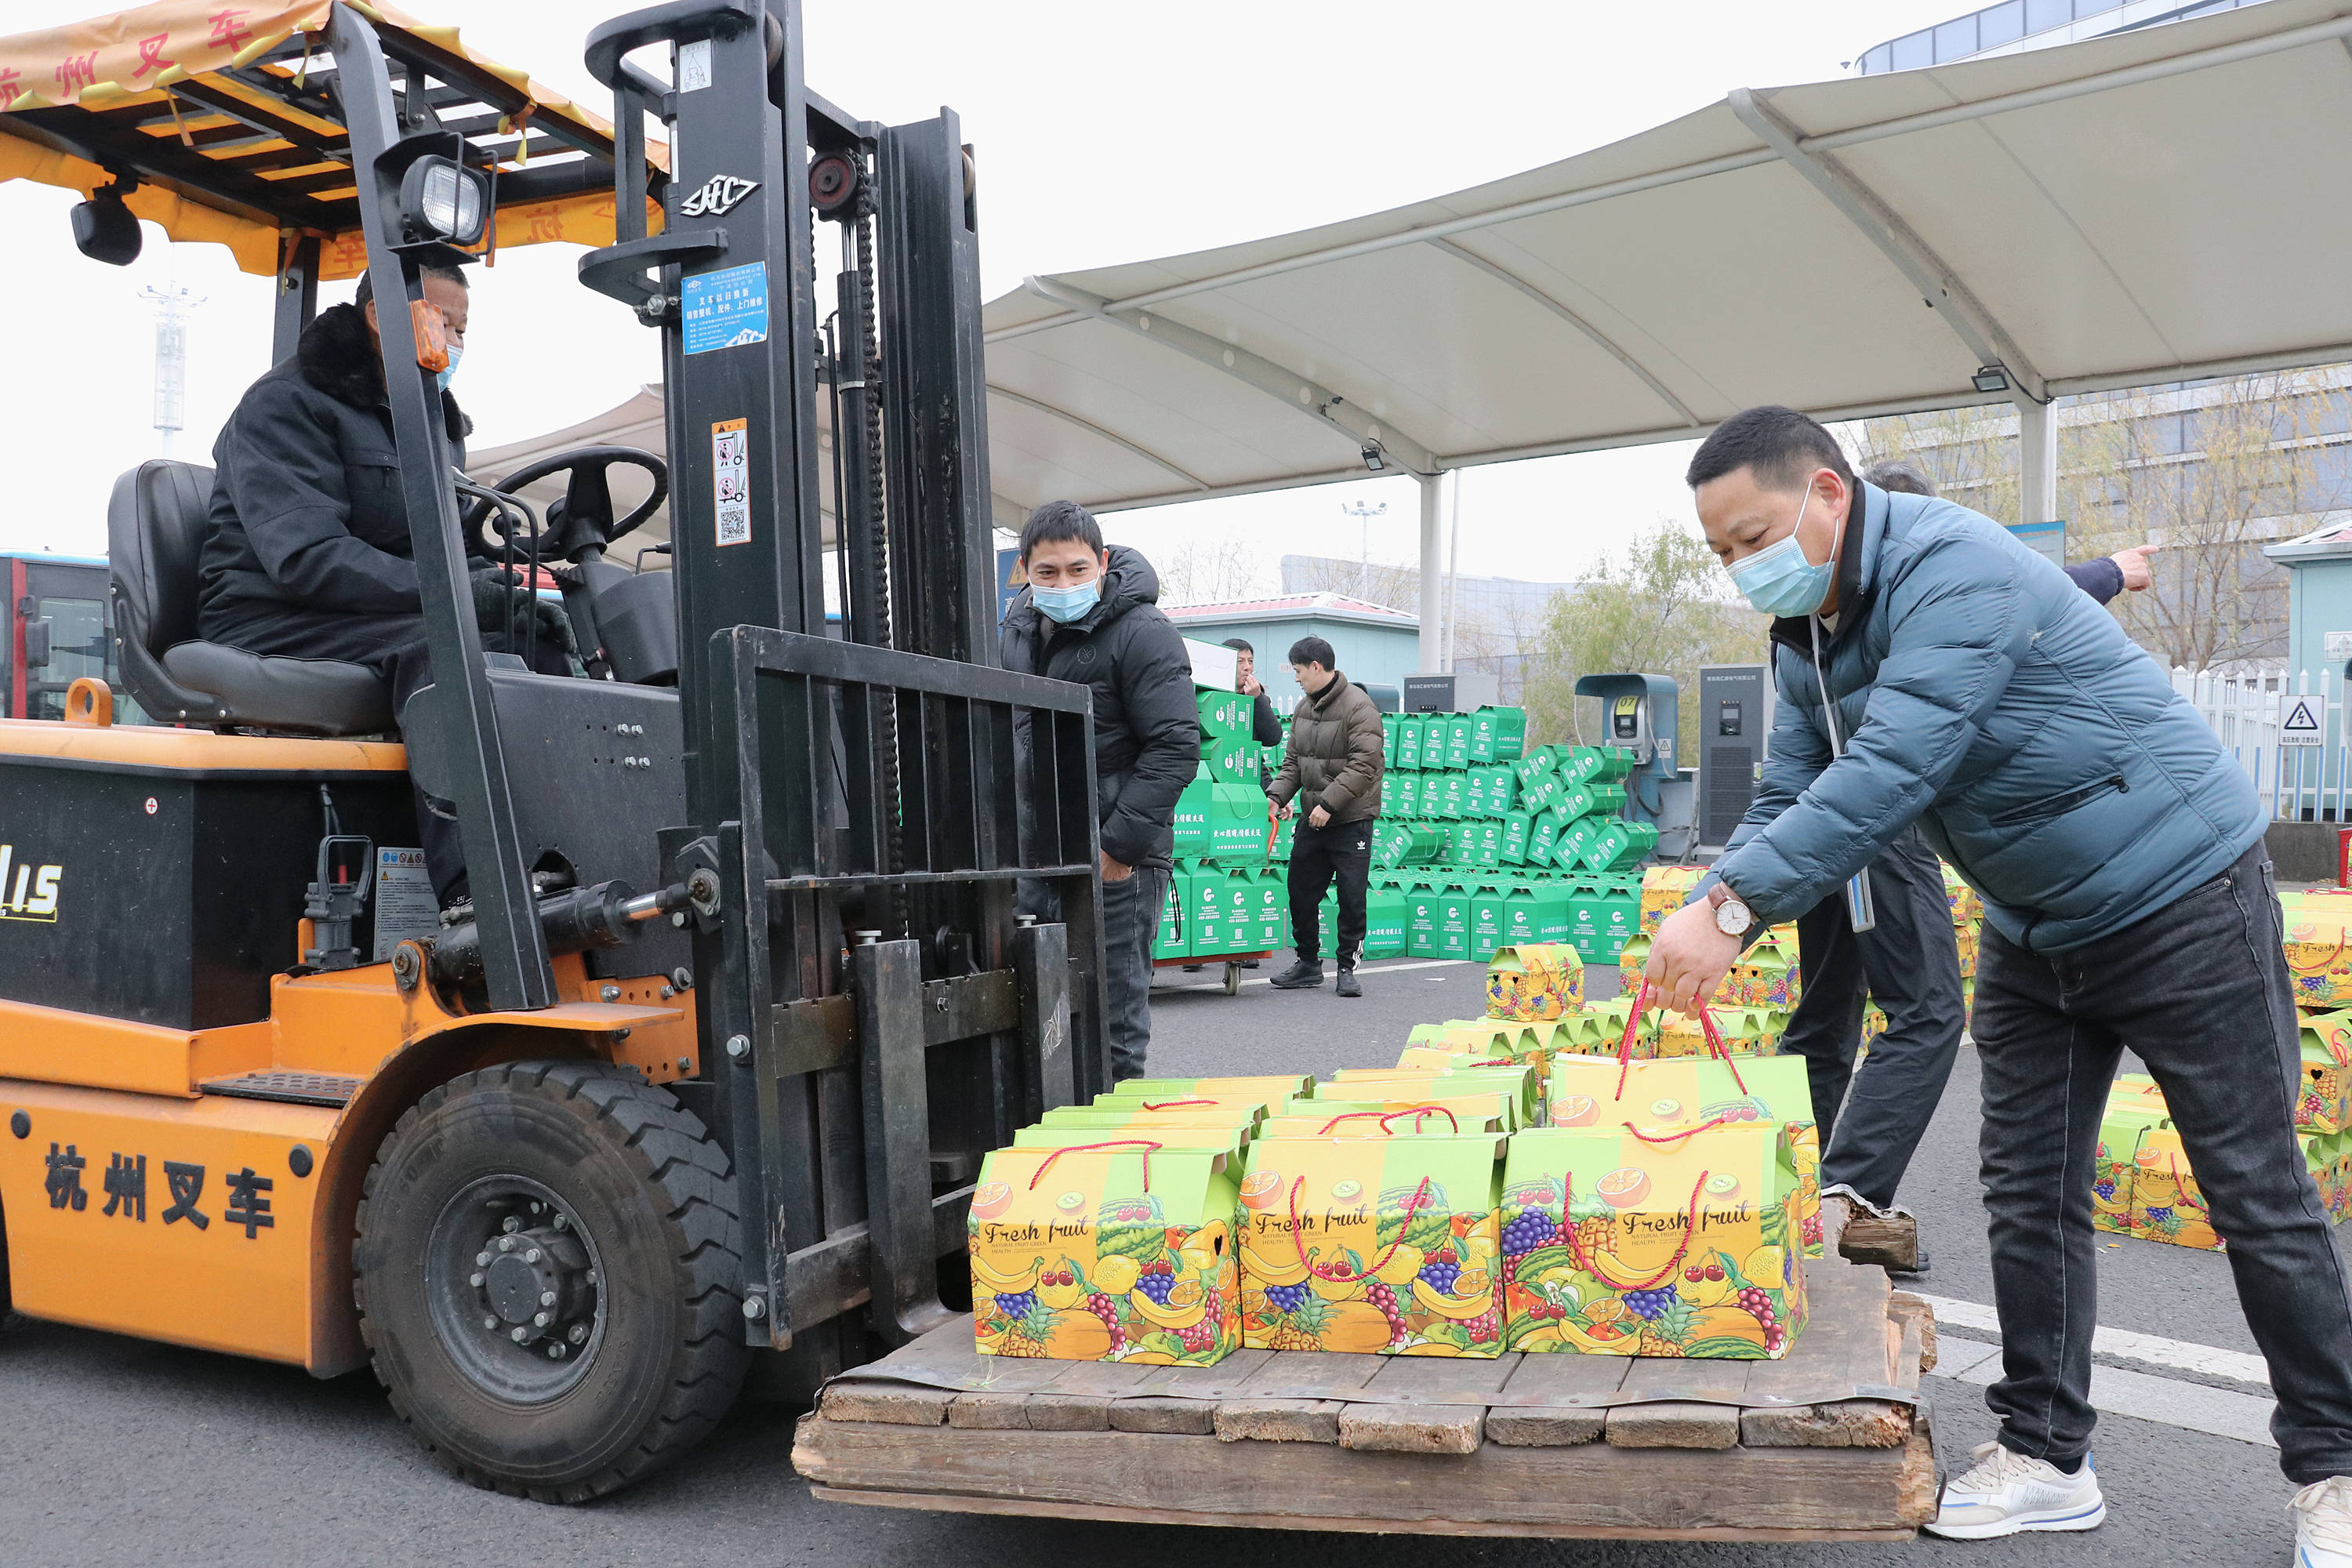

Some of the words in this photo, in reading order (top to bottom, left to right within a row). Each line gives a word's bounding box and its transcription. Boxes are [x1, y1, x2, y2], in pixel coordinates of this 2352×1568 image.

[699, 288, 750, 306] 叉车以旧换新
[1621, 697, 1635, 707] 07
[2303, 941, 2336, 953] Fresh
[2143, 1168, 2177, 1181] Fresh
[45, 1142, 274, 1239] 杭州叉车
[1255, 1209, 1316, 1235] Fresh
[1325, 1203, 1374, 1232] fruit
[1623, 1207, 1690, 1235] Fresh
[1702, 1200, 1756, 1232] fruit
[985, 1220, 1041, 1244] Fresh
[1048, 1215, 1095, 1243] fruit
